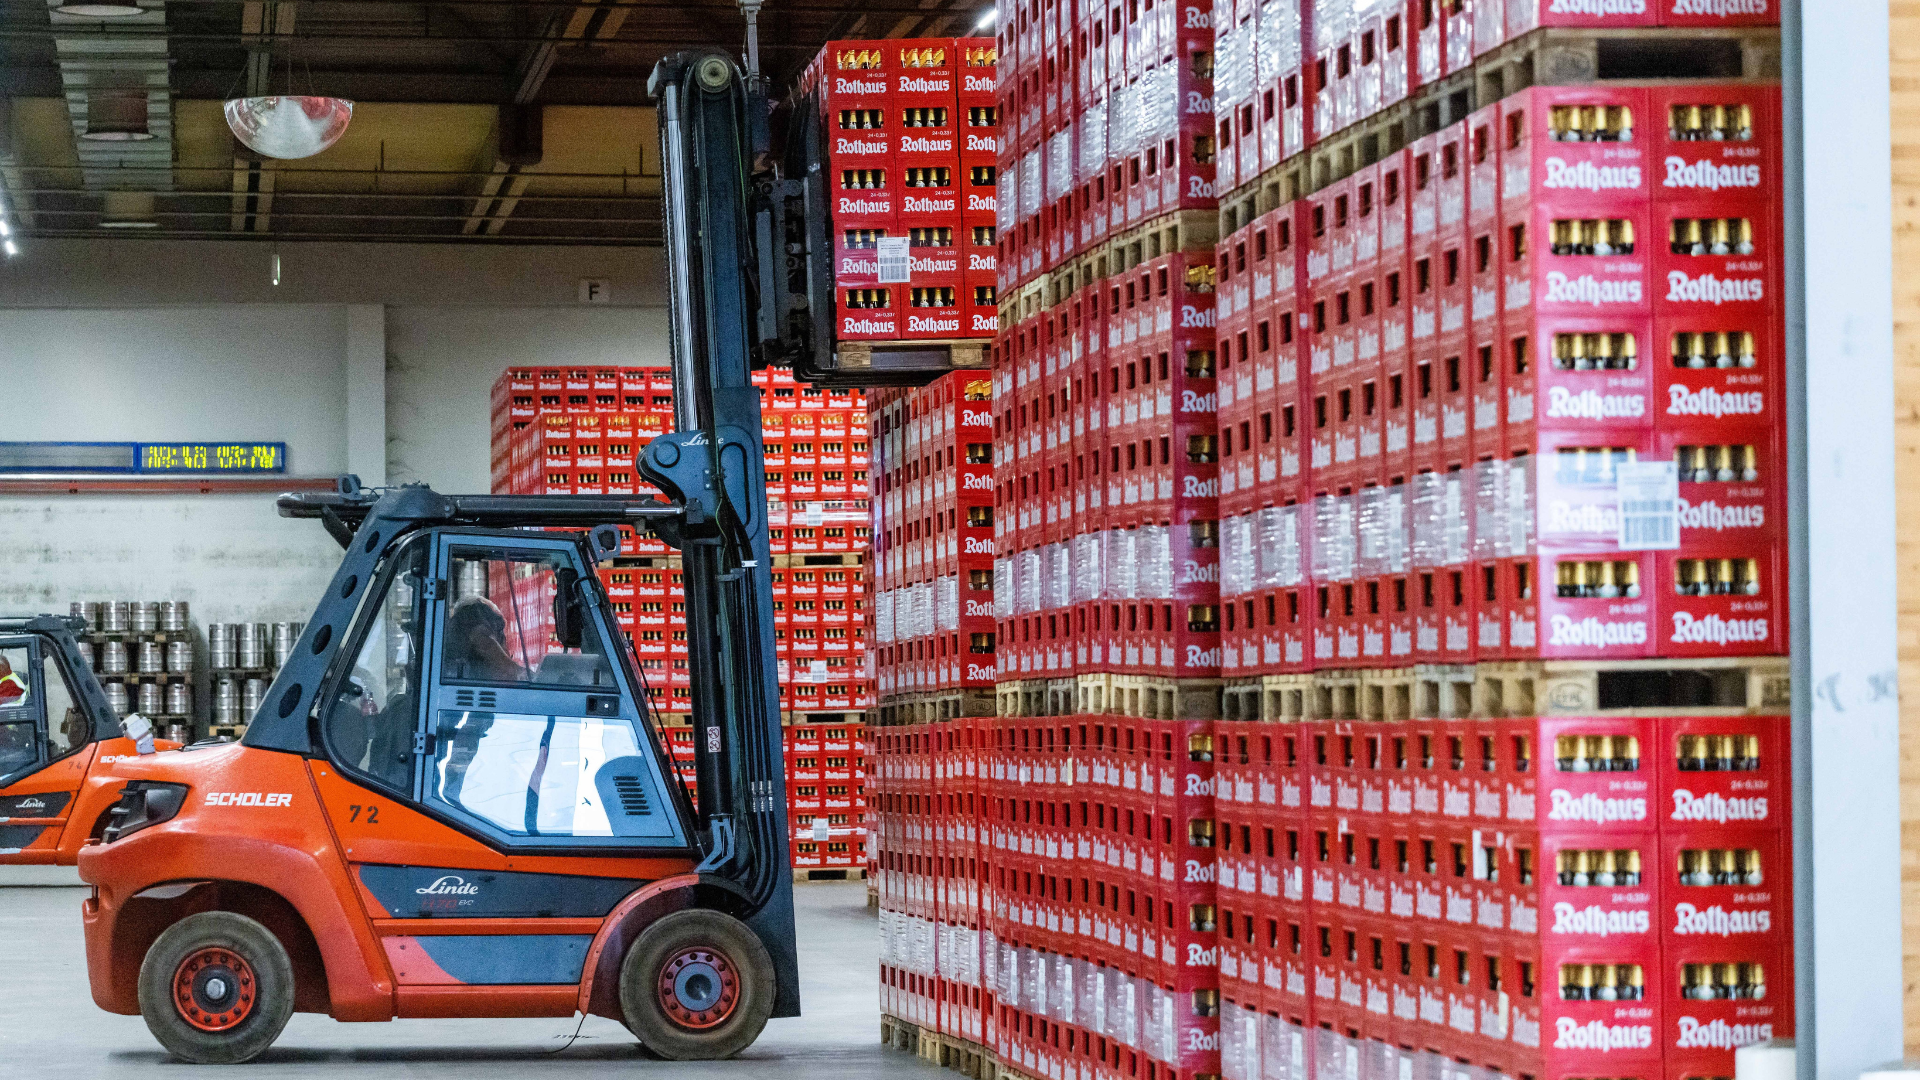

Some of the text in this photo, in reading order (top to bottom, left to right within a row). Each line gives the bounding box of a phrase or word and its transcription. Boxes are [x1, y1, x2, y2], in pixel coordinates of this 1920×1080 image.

[835, 78, 886, 95] Rothaus
[899, 76, 949, 93] Rothaus
[836, 138, 887, 155] Rothaus
[900, 136, 951, 153] Rothaus
[1543, 157, 1641, 192] Rothaus
[1663, 156, 1759, 190] Rothaus
[839, 198, 890, 215] Rothaus
[903, 196, 955, 213] Rothaus
[588, 283, 600, 300] F
[1543, 271, 1641, 306] Rothaus
[1666, 271, 1762, 305] Rothaus
[843, 318, 894, 335] Rothaus
[908, 316, 959, 333] Rothaus
[1547, 386, 1644, 420] Rothaus
[1667, 384, 1763, 418] Rothaus
[681, 432, 724, 446] Line
[1547, 611, 1646, 648] Rothaus
[1671, 611, 1767, 645] Rothaus
[16, 798, 46, 808] Linde
[350, 805, 378, 823] 72
[1548, 789, 1646, 824] Rothaus
[1671, 789, 1768, 824] Rothaus
[416, 876, 478, 894] Linde
[1551, 902, 1649, 937] Rothaus
[1674, 903, 1770, 937] Rothaus
[1554, 1017, 1651, 1052] Rothaus
